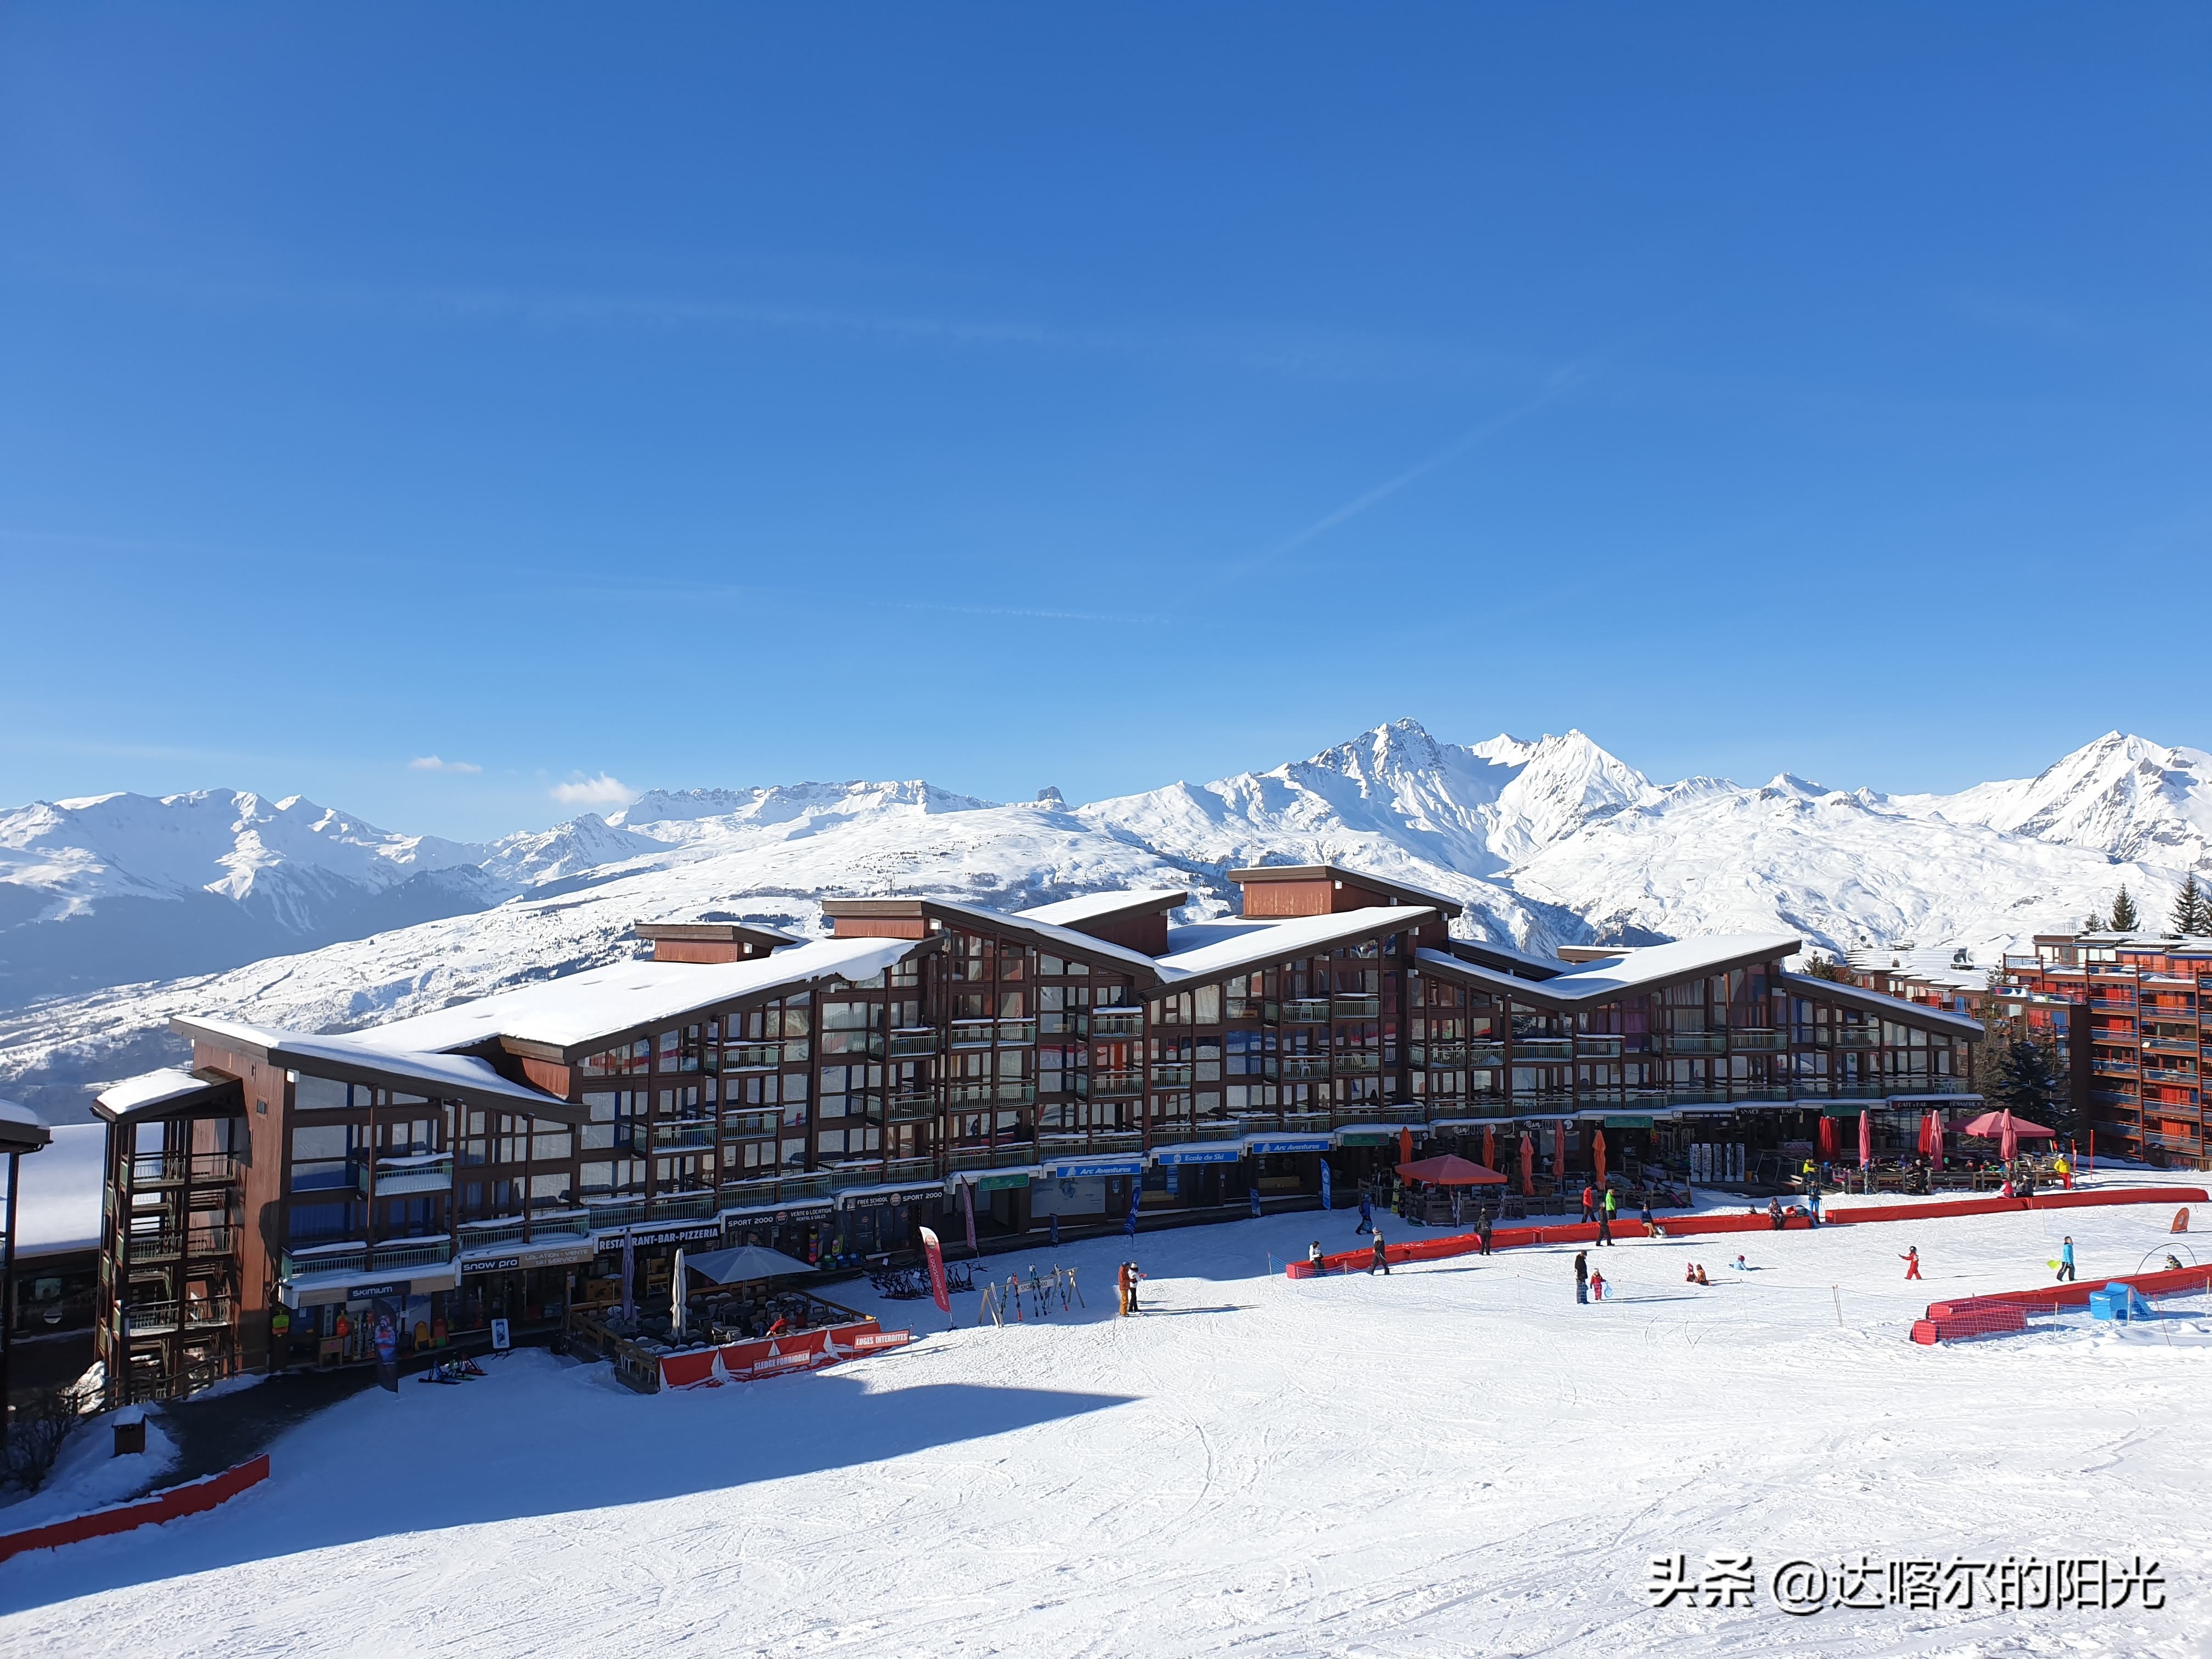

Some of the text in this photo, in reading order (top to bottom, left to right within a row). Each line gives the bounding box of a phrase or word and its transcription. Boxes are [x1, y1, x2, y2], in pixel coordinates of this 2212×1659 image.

[810, 1207, 832, 1215] LOCATION
[728, 1218, 752, 1227] SPORT
[754, 1216, 774, 1224] 2000
[599, 1228, 719, 1251] RESTARANT-BAR-PIZZERIA
[525, 1252, 559, 1261] LOCATION
[548, 1256, 578, 1265] SERVICE
[856, 1333, 909, 1346] LUGES INTERDITES
[754, 1352, 810, 1371] SLEDGE FORBIDDEN
